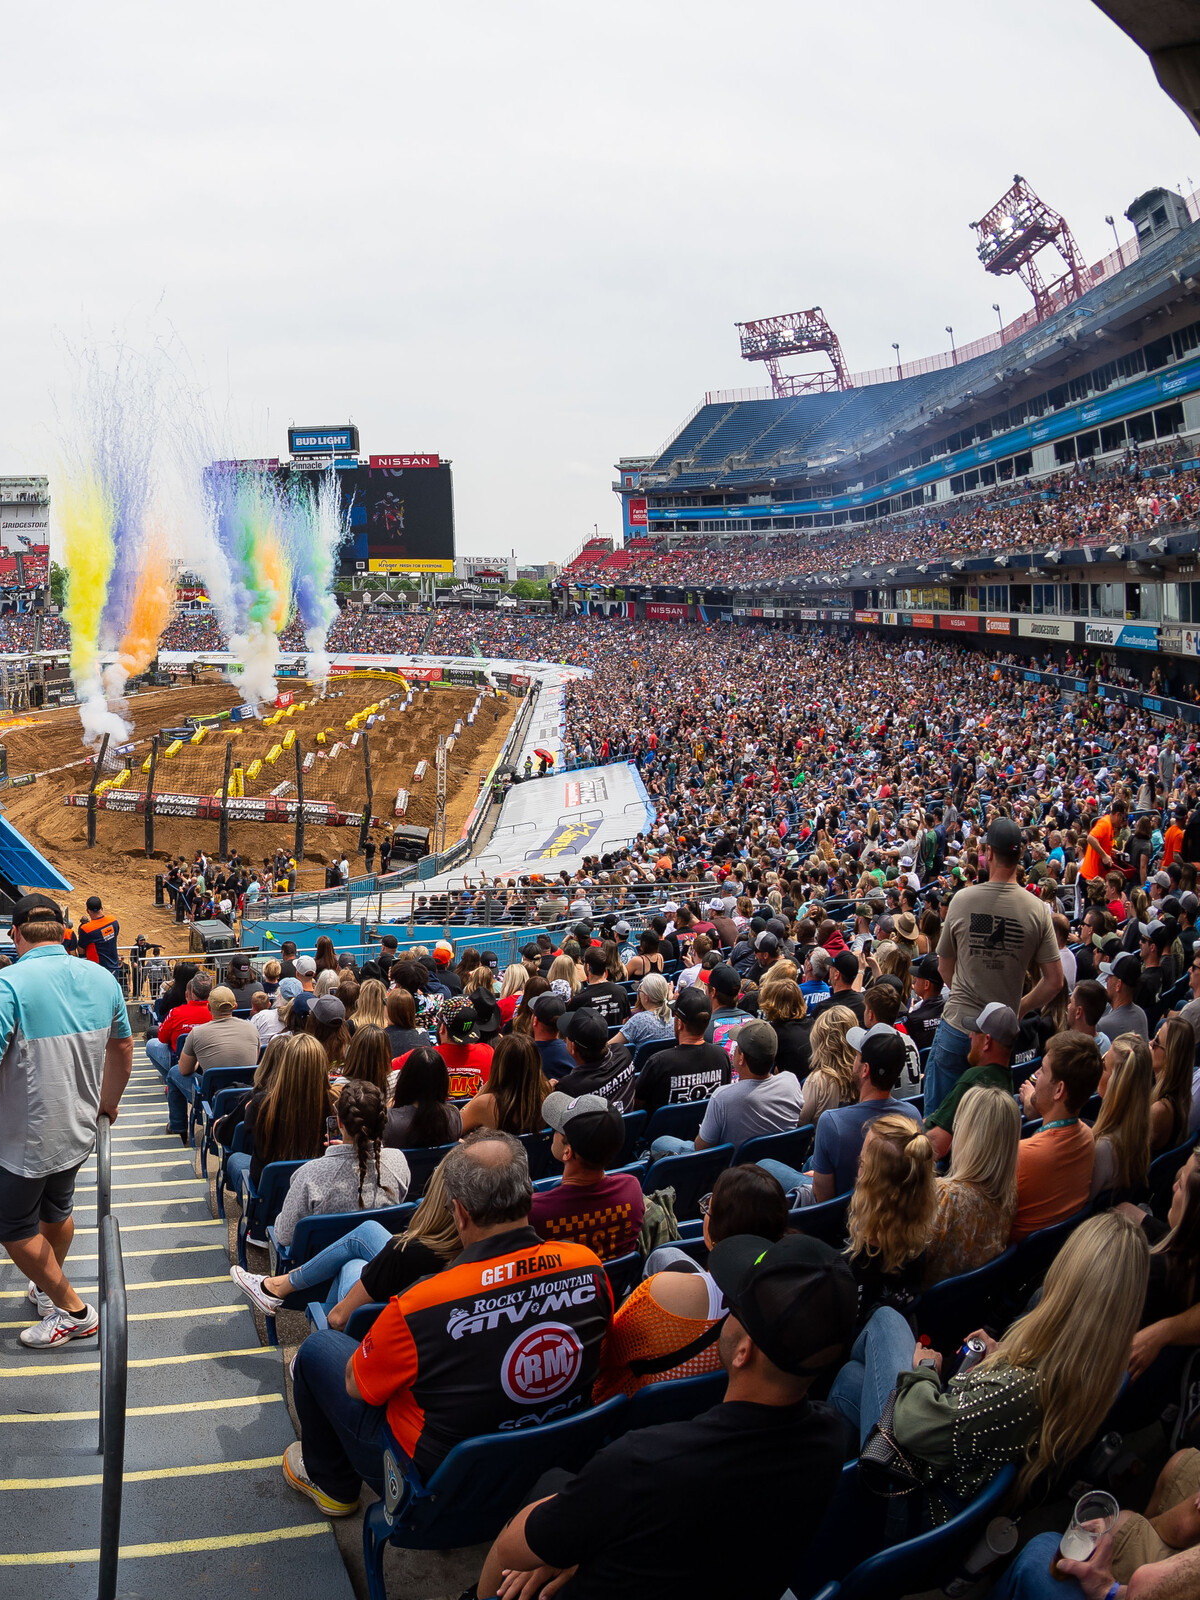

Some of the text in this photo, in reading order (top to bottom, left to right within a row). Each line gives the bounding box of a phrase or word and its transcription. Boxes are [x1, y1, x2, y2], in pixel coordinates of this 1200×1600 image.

[296, 436, 347, 446] BUD LIGHT
[290, 462, 322, 470] Pinnacle
[378, 458, 430, 466] NISSAN
[378, 560, 398, 571] Kroger
[650, 606, 683, 614] NISSAN
[1030, 622, 1060, 636] BRIDGESTONE
[1086, 625, 1114, 644] Pinnacle
[670, 1069, 722, 1088] BITTERMAN
[473, 1273, 593, 1313] ROCKY MOUNTAIN
[524, 1346, 568, 1385] RM
